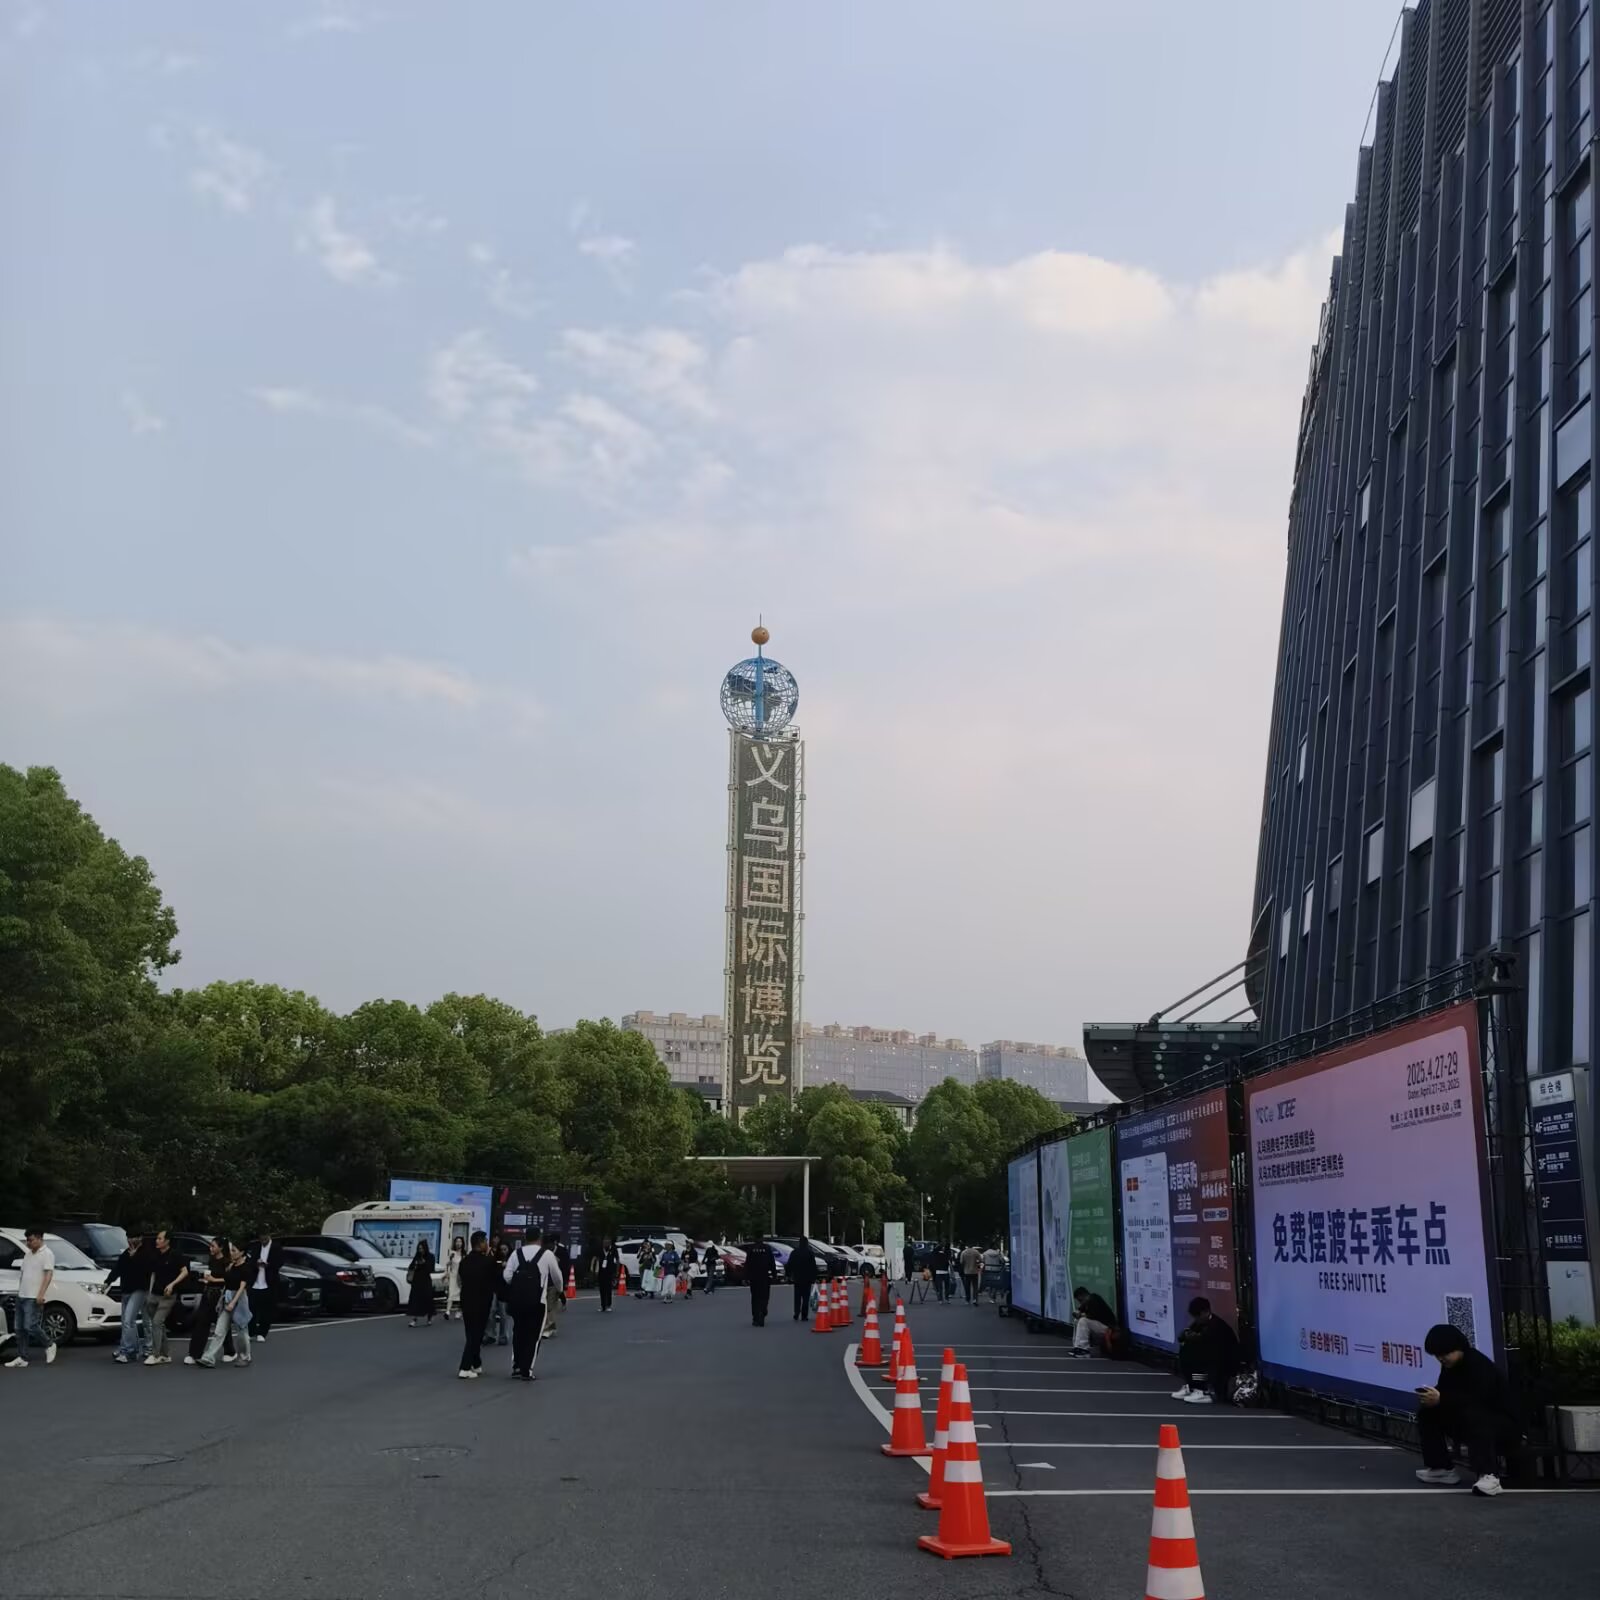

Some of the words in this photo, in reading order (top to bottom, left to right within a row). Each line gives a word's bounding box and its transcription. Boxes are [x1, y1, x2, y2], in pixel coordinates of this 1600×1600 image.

[738, 743, 790, 1127] 义乌国际博览
[1407, 1051, 1458, 1086] 2025.4.27-29
[1535, 1122, 1543, 1133] 4F
[1539, 1158, 1547, 1170] 3F
[1542, 1196, 1550, 1208] 2F
[1272, 1201, 1451, 1266] 免费摆渡车乘车点
[1545, 1236, 1553, 1248] 1F
[1318, 1271, 1341, 1291] FREE
[1341, 1273, 1388, 1294] SHUTTLE
[1309, 1329, 1350, 1357] 综合楼1号门
[1381, 1341, 1424, 1369] 前门7号门
